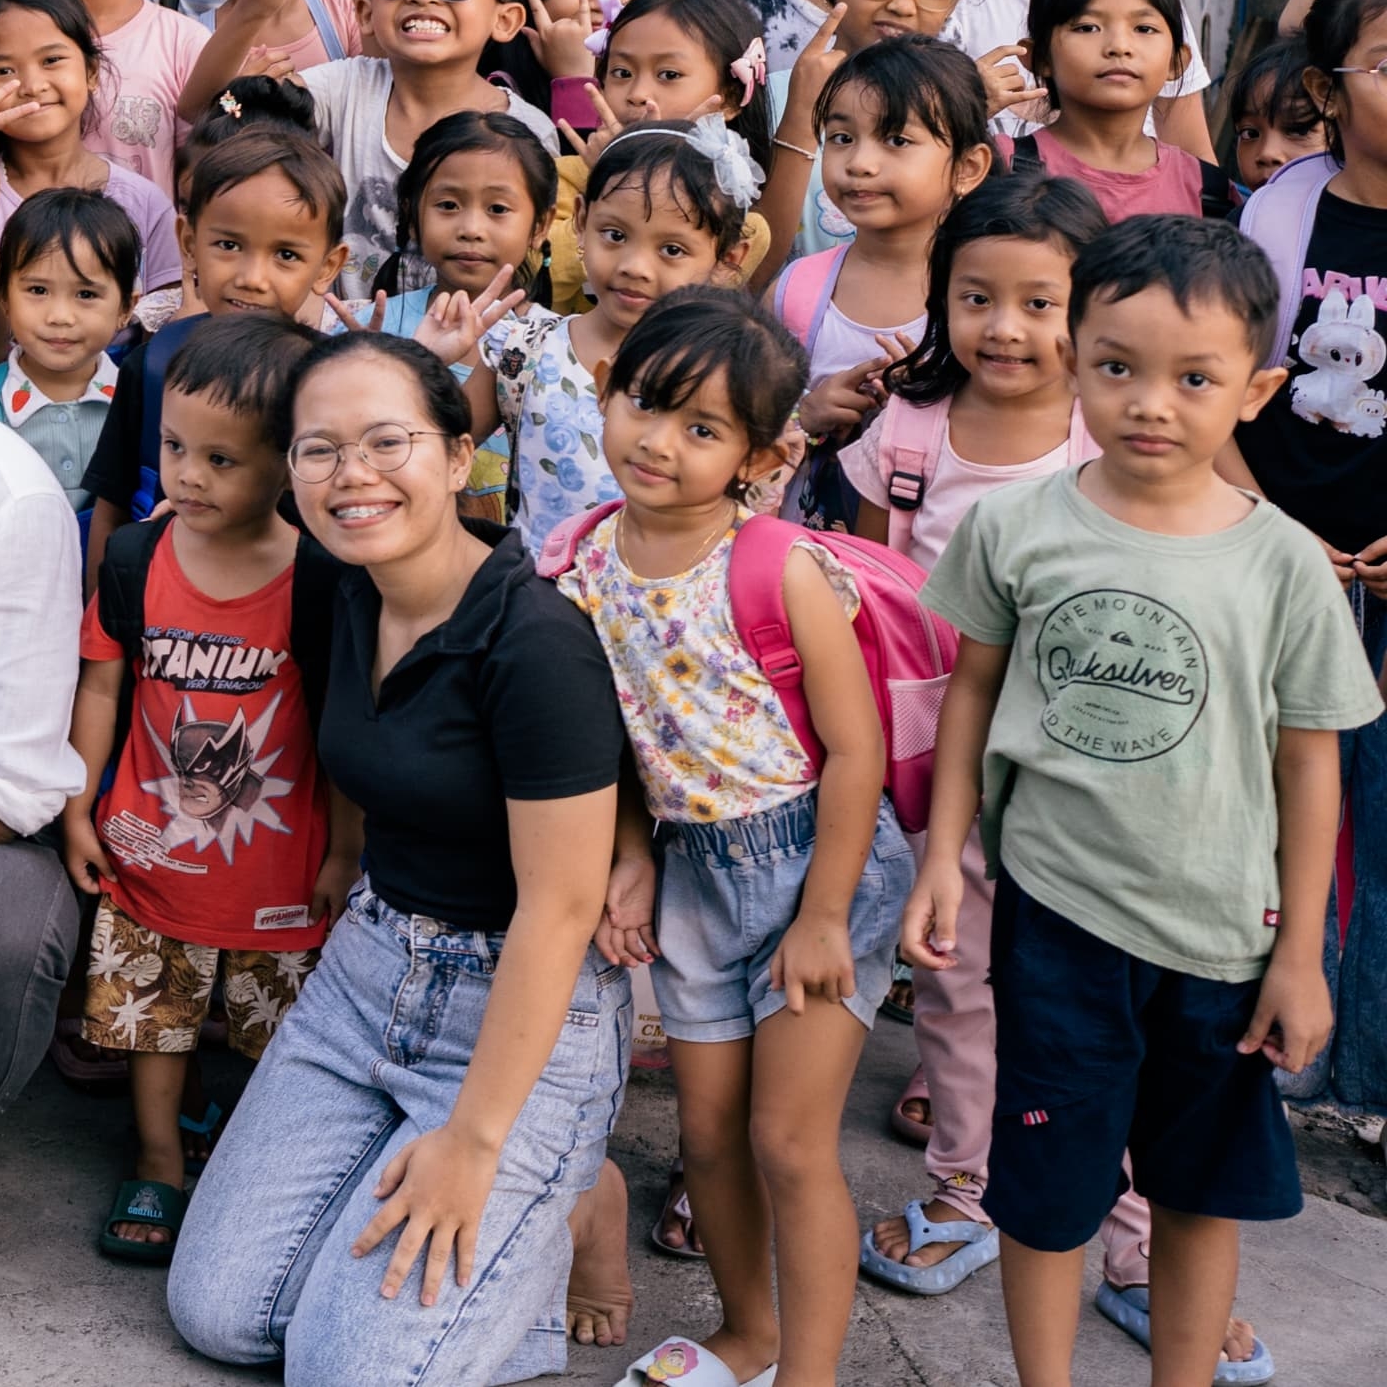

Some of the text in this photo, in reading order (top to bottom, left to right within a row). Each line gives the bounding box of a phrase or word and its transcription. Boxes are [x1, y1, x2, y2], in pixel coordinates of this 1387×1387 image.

[166, 627, 194, 641] FROM
[198, 632, 247, 645] FUTURE
[1049, 598, 1198, 669] THE MOUNTAIN
[185, 679, 210, 689] VERY
[1064, 725, 1105, 751] THE
[1111, 728, 1173, 754] WAVE
[127, 1206, 163, 1219] GODZILLA
